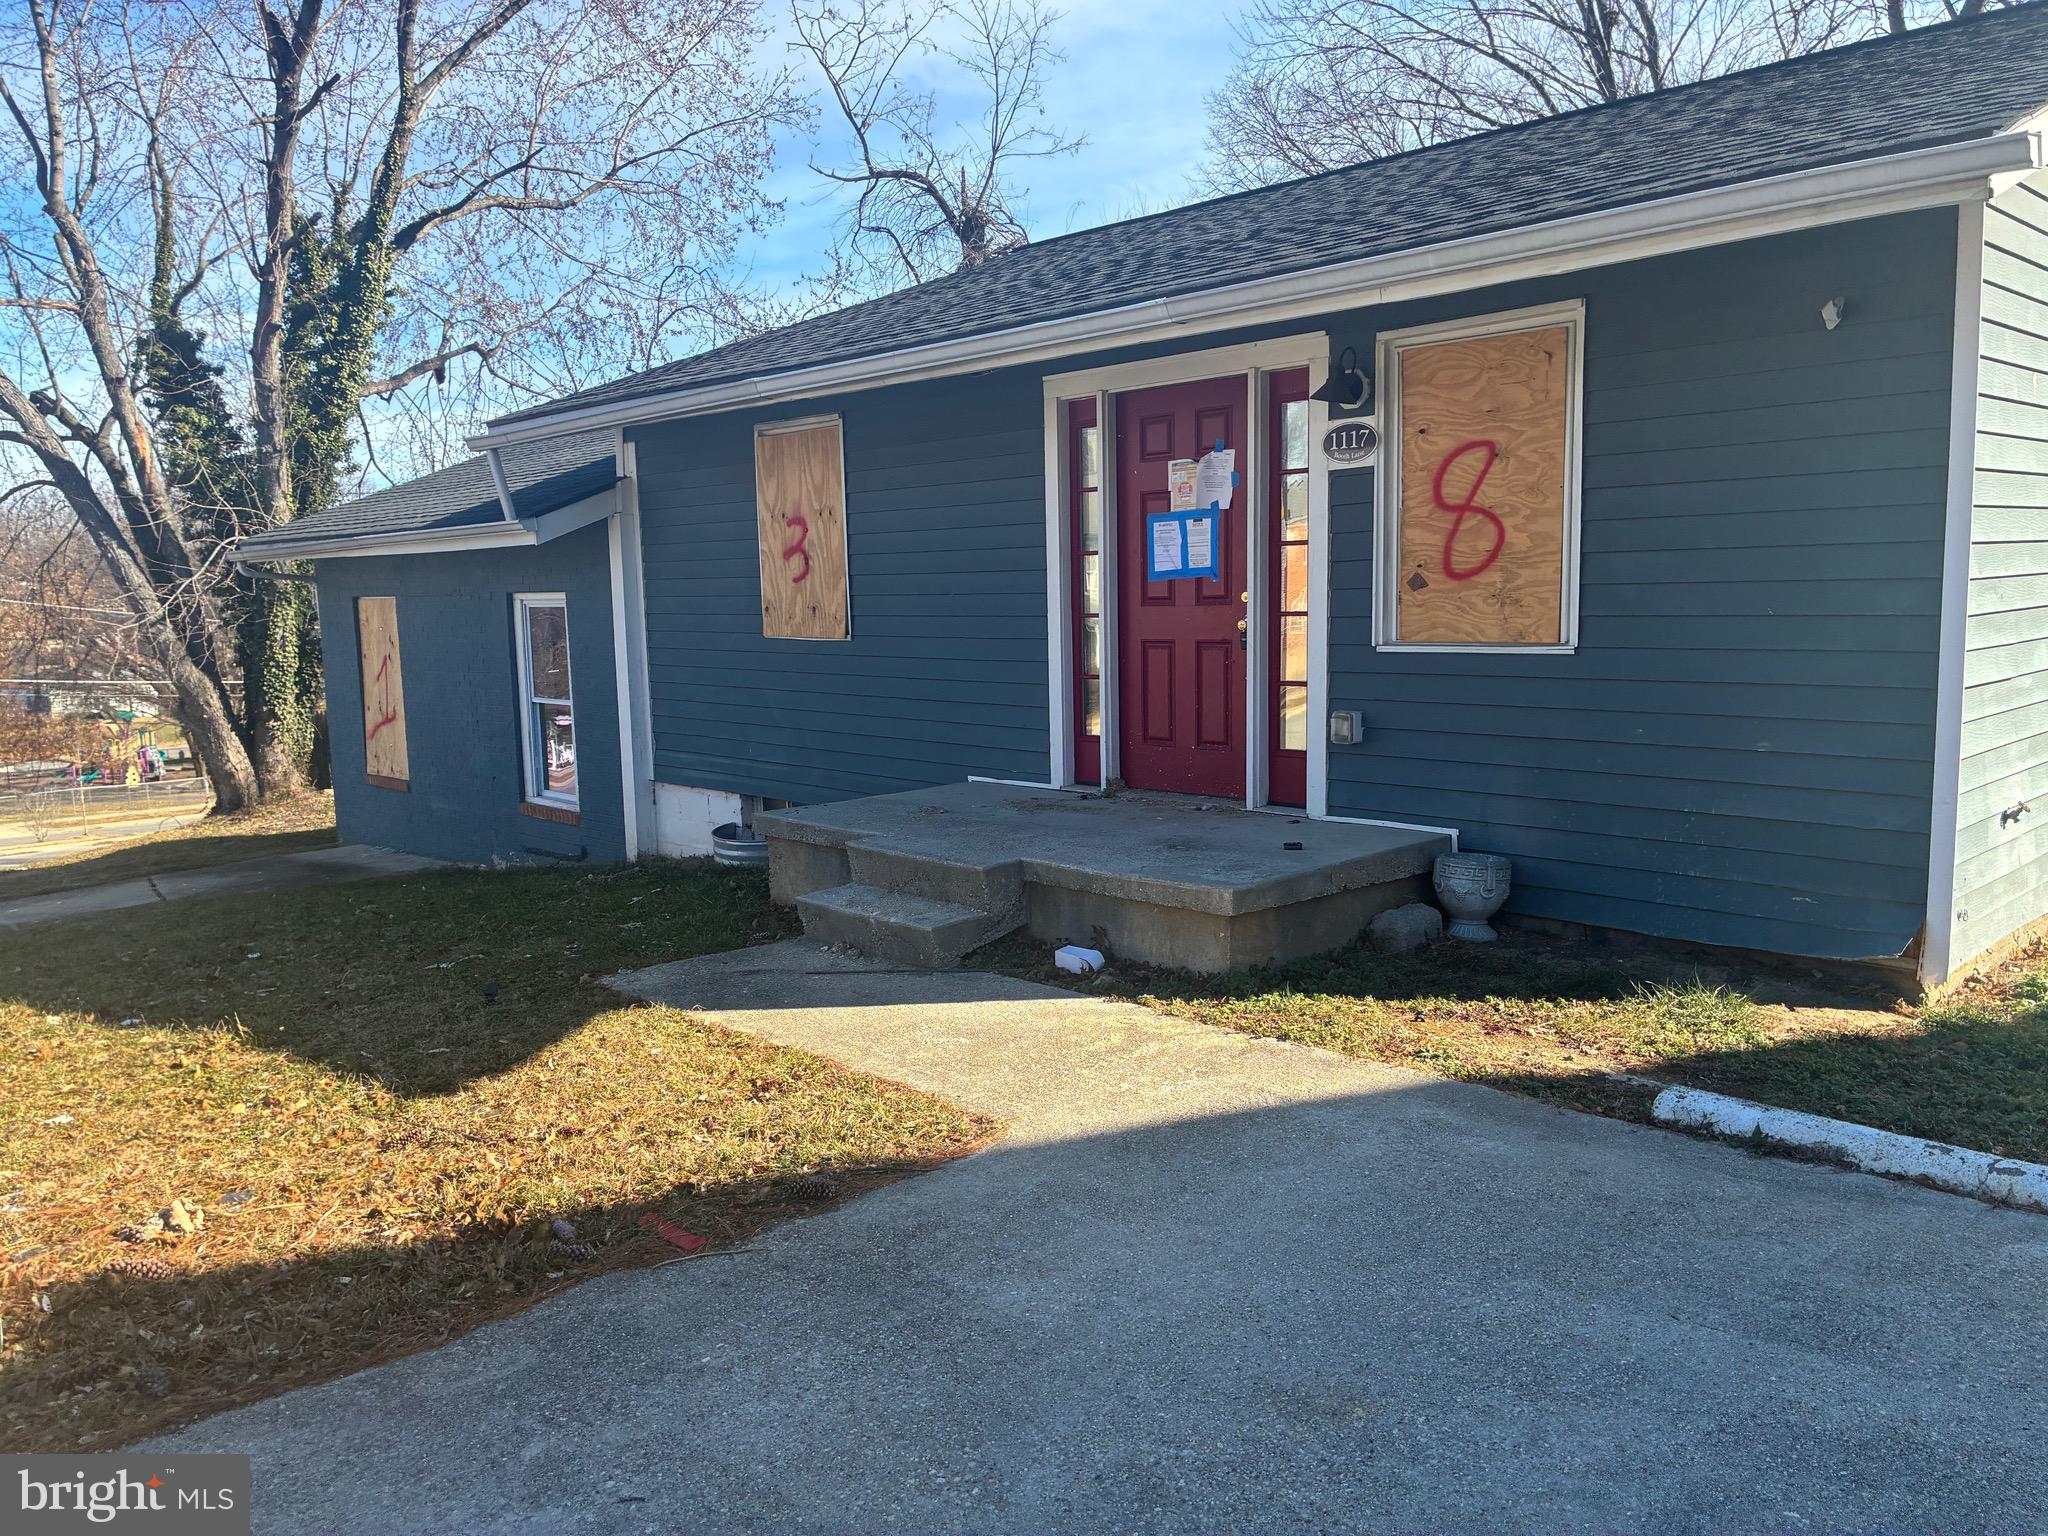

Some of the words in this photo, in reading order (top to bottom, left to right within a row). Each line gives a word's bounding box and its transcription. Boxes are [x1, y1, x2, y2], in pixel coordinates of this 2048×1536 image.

[1330, 429, 1370, 451] 1117
[1432, 439, 1506, 581] 8
[783, 516, 810, 584] 3
